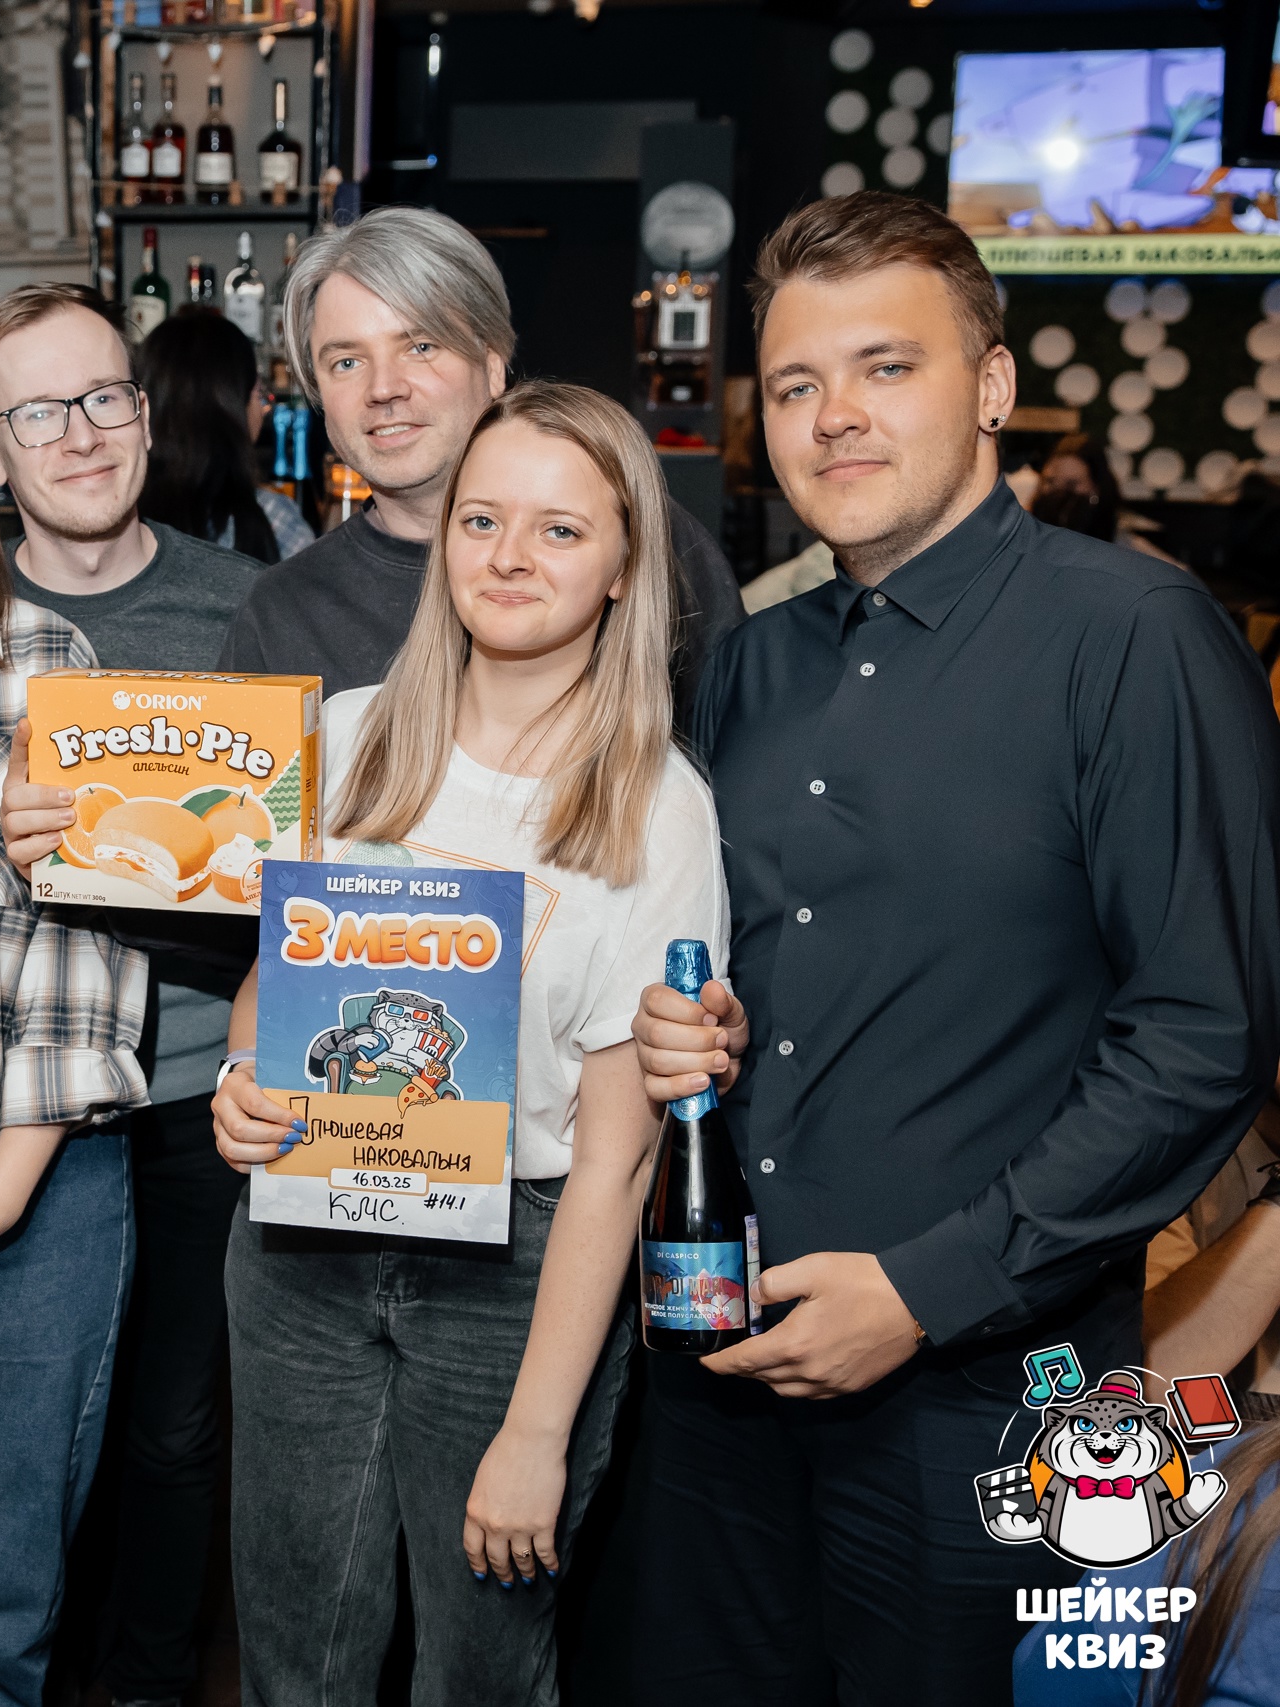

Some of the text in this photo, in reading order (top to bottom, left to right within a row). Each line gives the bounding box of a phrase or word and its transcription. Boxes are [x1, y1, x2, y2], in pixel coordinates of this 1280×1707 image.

[135, 693, 202, 711] ORION
[132, 761, 191, 777] апельсин
[36, 882, 53, 897] 12
[326, 874, 461, 898] ШЕЙКЕР КВИЗ
[286, 903, 497, 967] 3 МЕСТО
[353, 1145, 471, 1172] НАКОВАЛЬНЯ
[352, 1172, 411, 1189] 16.03.25
[666, 1252, 699, 1260] CASPICO
